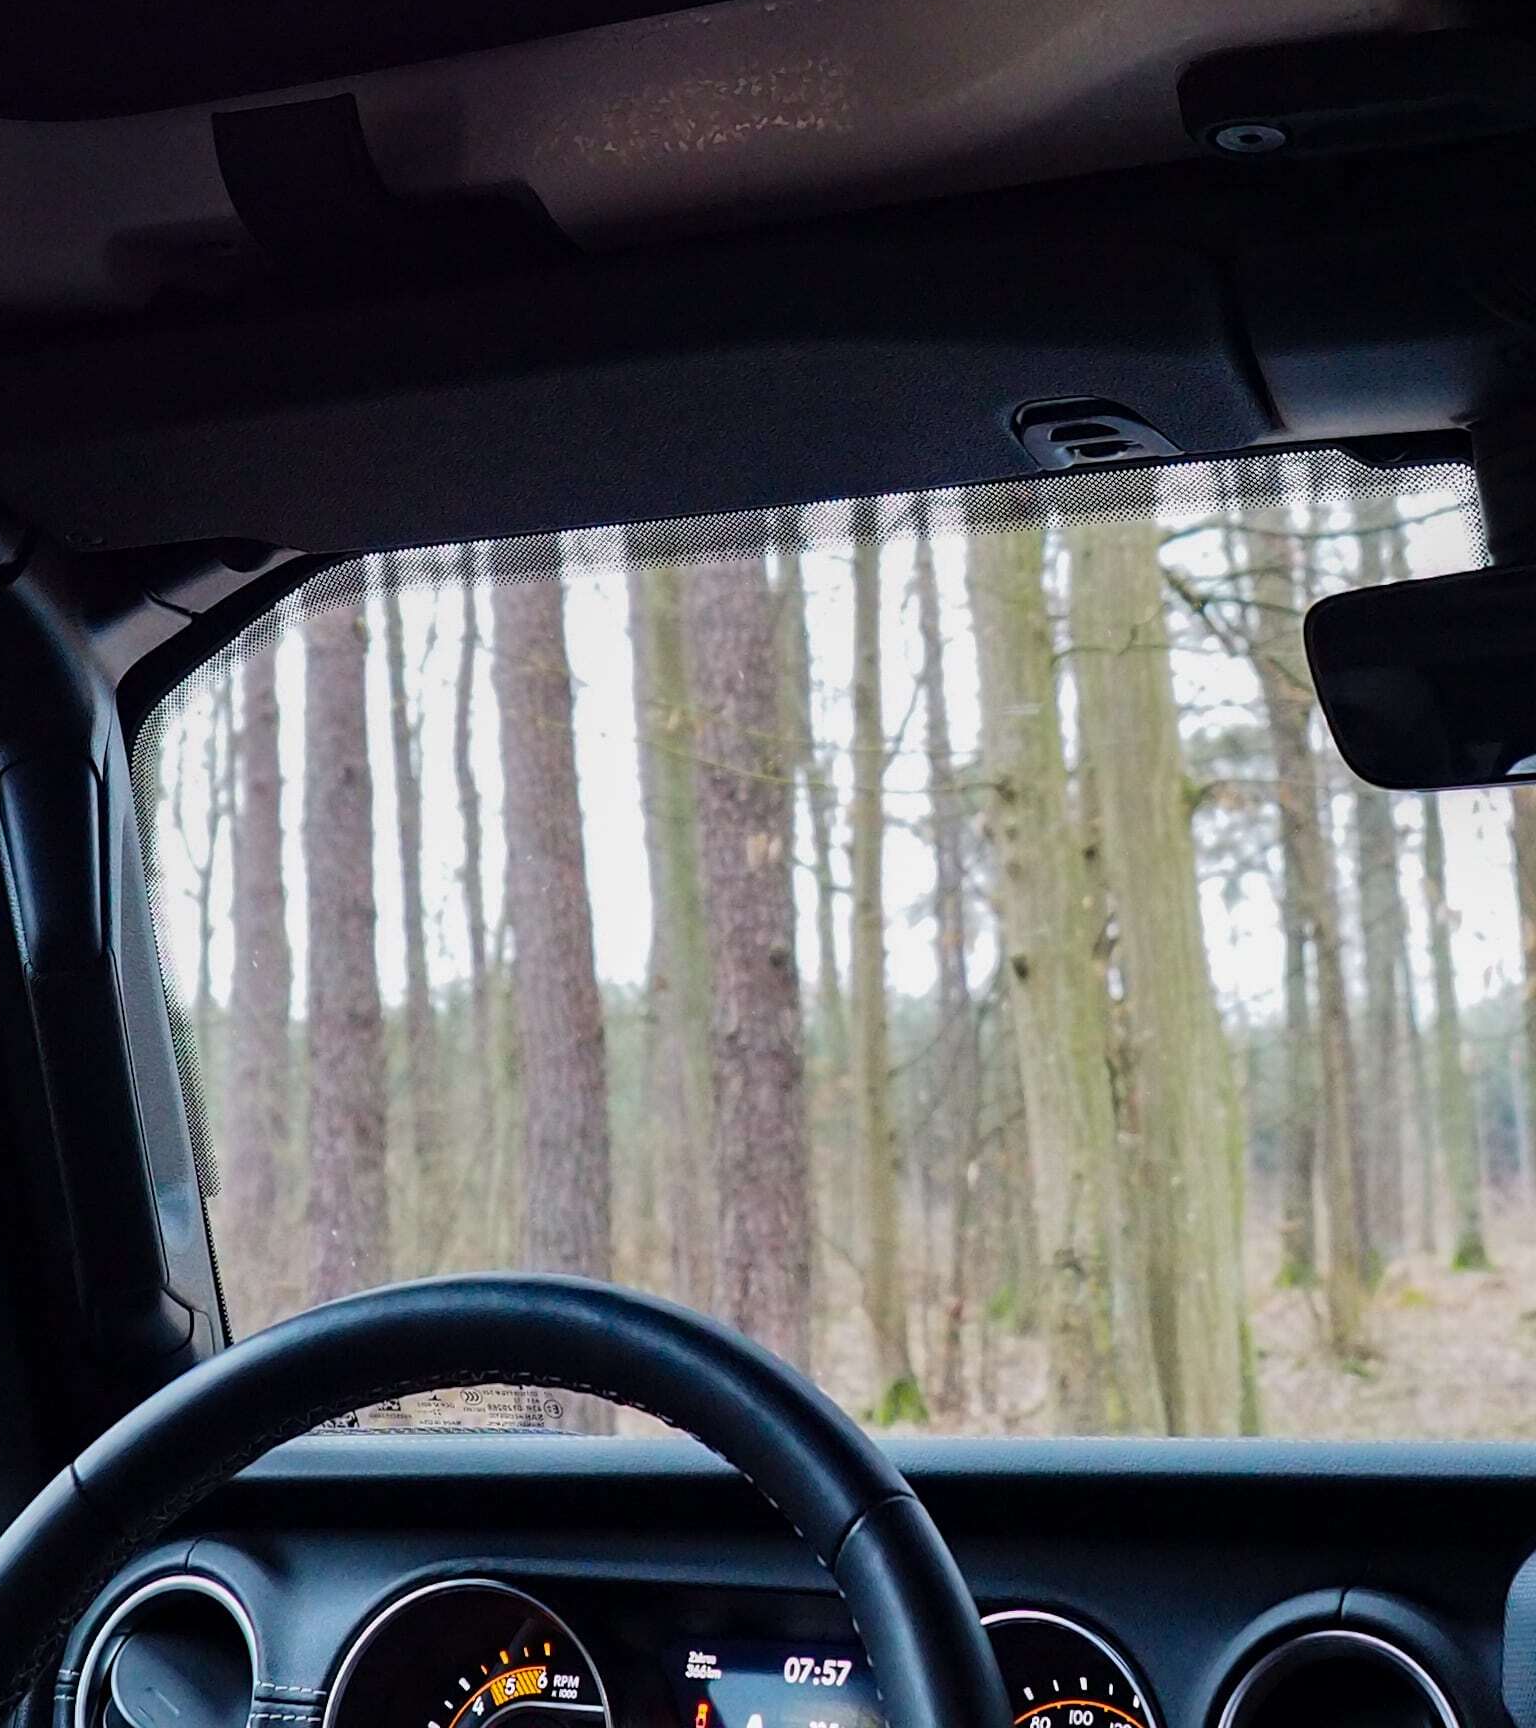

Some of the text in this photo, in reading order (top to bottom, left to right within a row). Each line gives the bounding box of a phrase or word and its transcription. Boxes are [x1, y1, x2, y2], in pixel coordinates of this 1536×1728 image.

[537, 1670, 549, 1689] 6
[783, 1656, 853, 1687] 07:57
[504, 1674, 517, 1696] 5
[553, 1674, 580, 1689] RPM
[472, 1695, 485, 1717] 4
[1029, 1715, 1052, 1728] 80
[1068, 1709, 1094, 1726] 100
